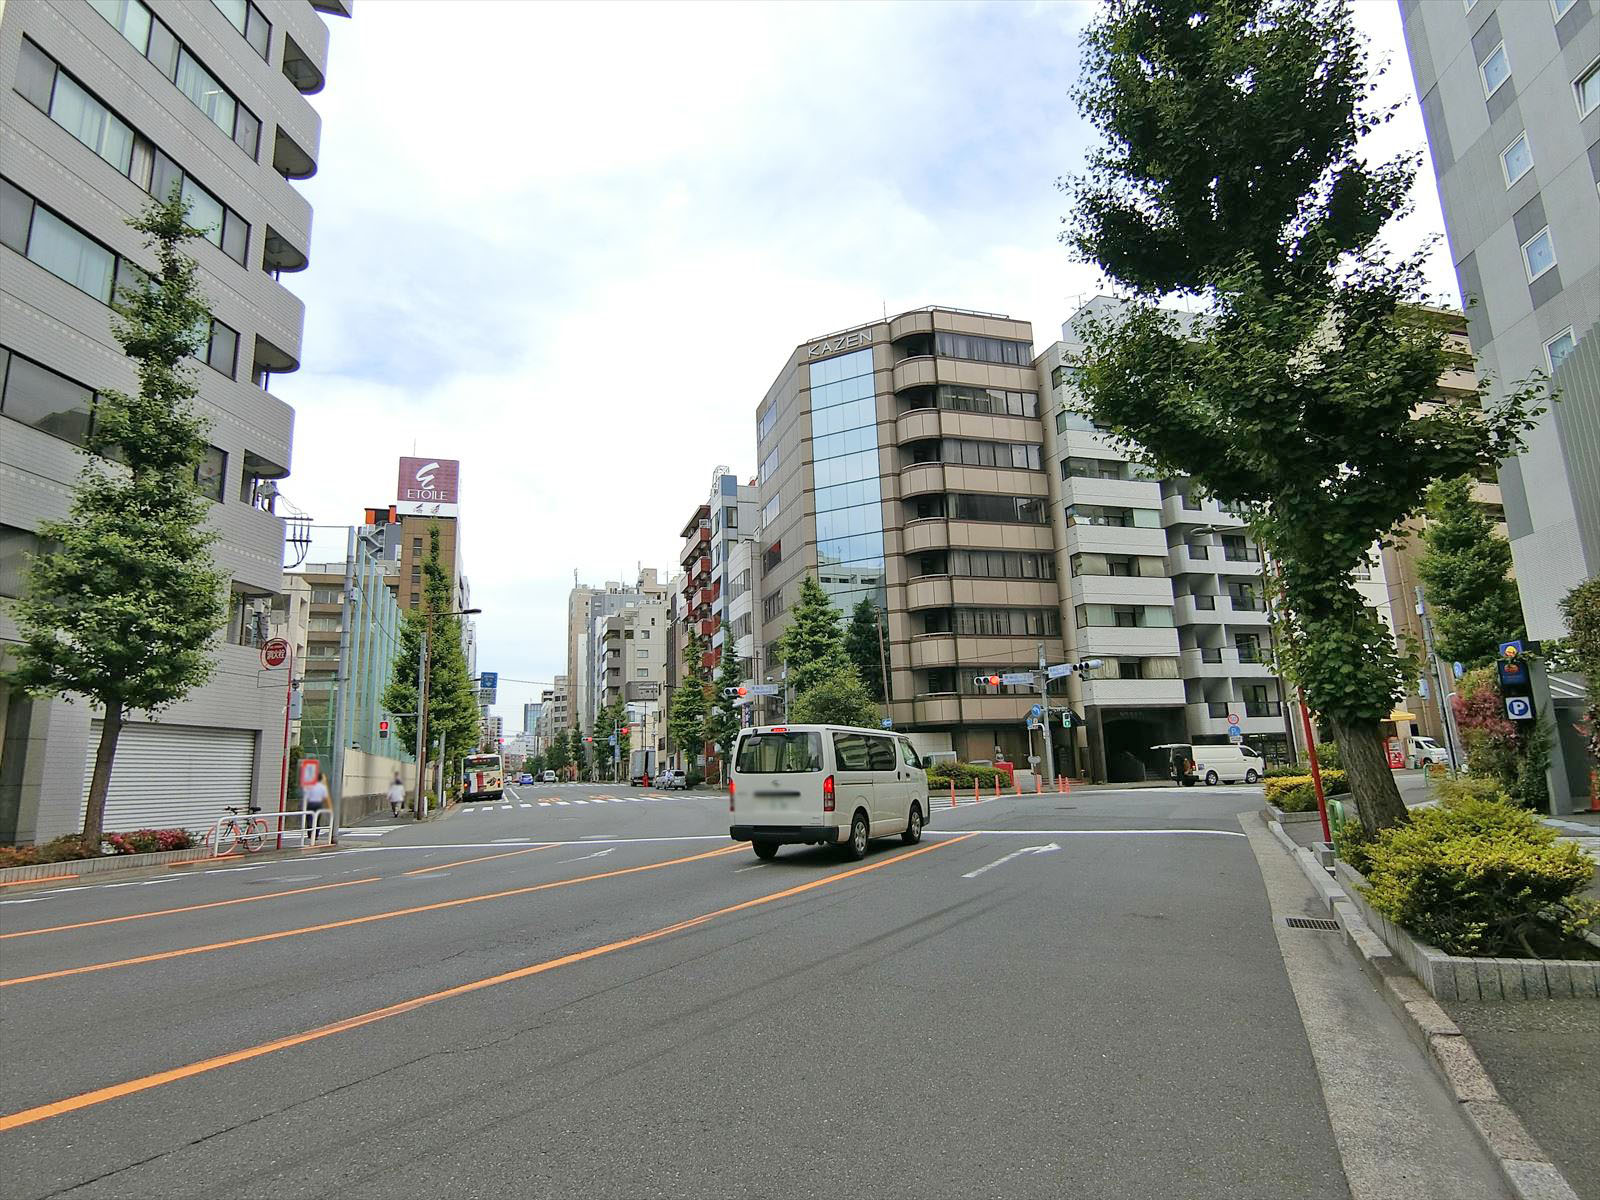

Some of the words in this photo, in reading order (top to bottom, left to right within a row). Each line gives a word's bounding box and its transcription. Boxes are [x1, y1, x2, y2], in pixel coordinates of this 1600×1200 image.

[808, 328, 873, 358] KAZEN
[407, 489, 448, 501] ETOILE
[1512, 701, 1525, 715] P
